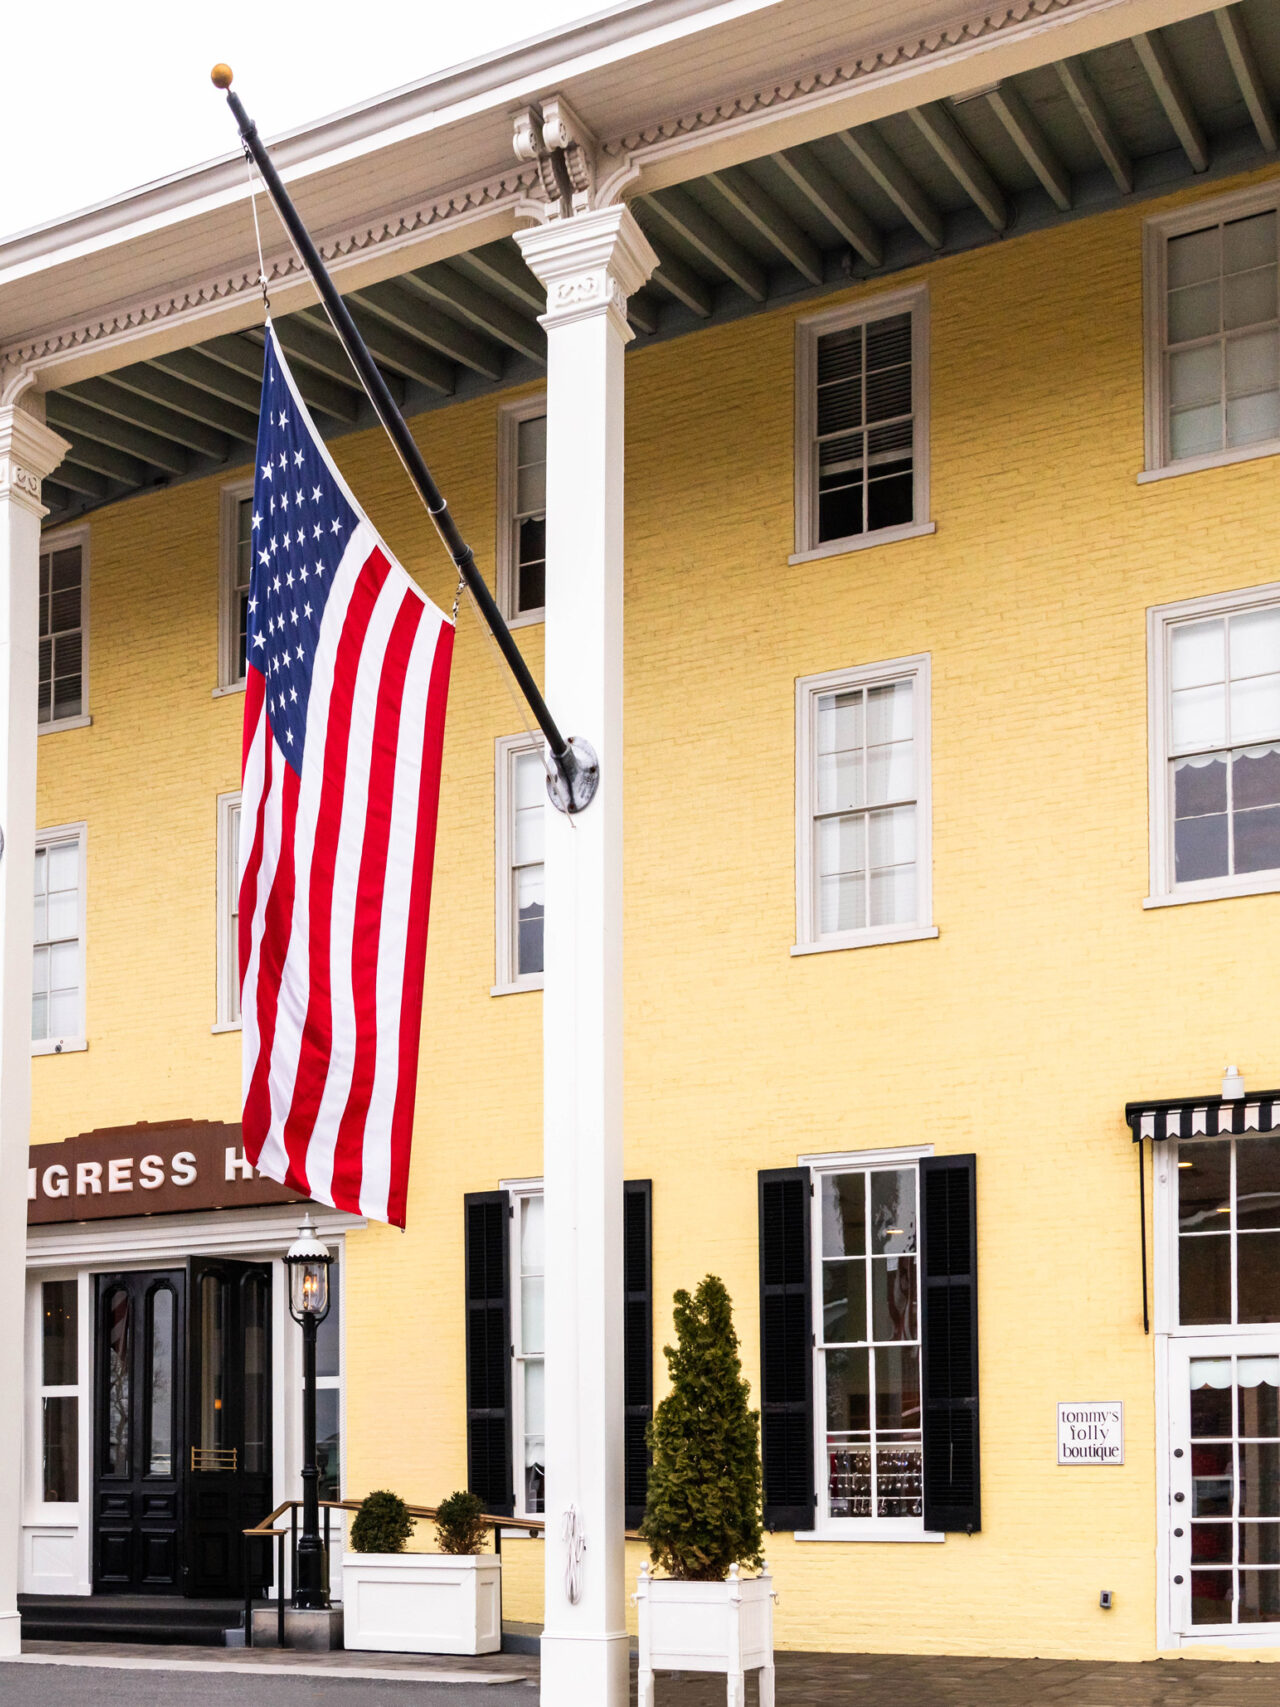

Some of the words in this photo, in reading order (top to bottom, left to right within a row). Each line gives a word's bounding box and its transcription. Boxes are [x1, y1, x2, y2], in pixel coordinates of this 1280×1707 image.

[1062, 1411, 1119, 1426] tommy's
[1070, 1425, 1109, 1445] folly
[1063, 1443, 1119, 1461] boutique
